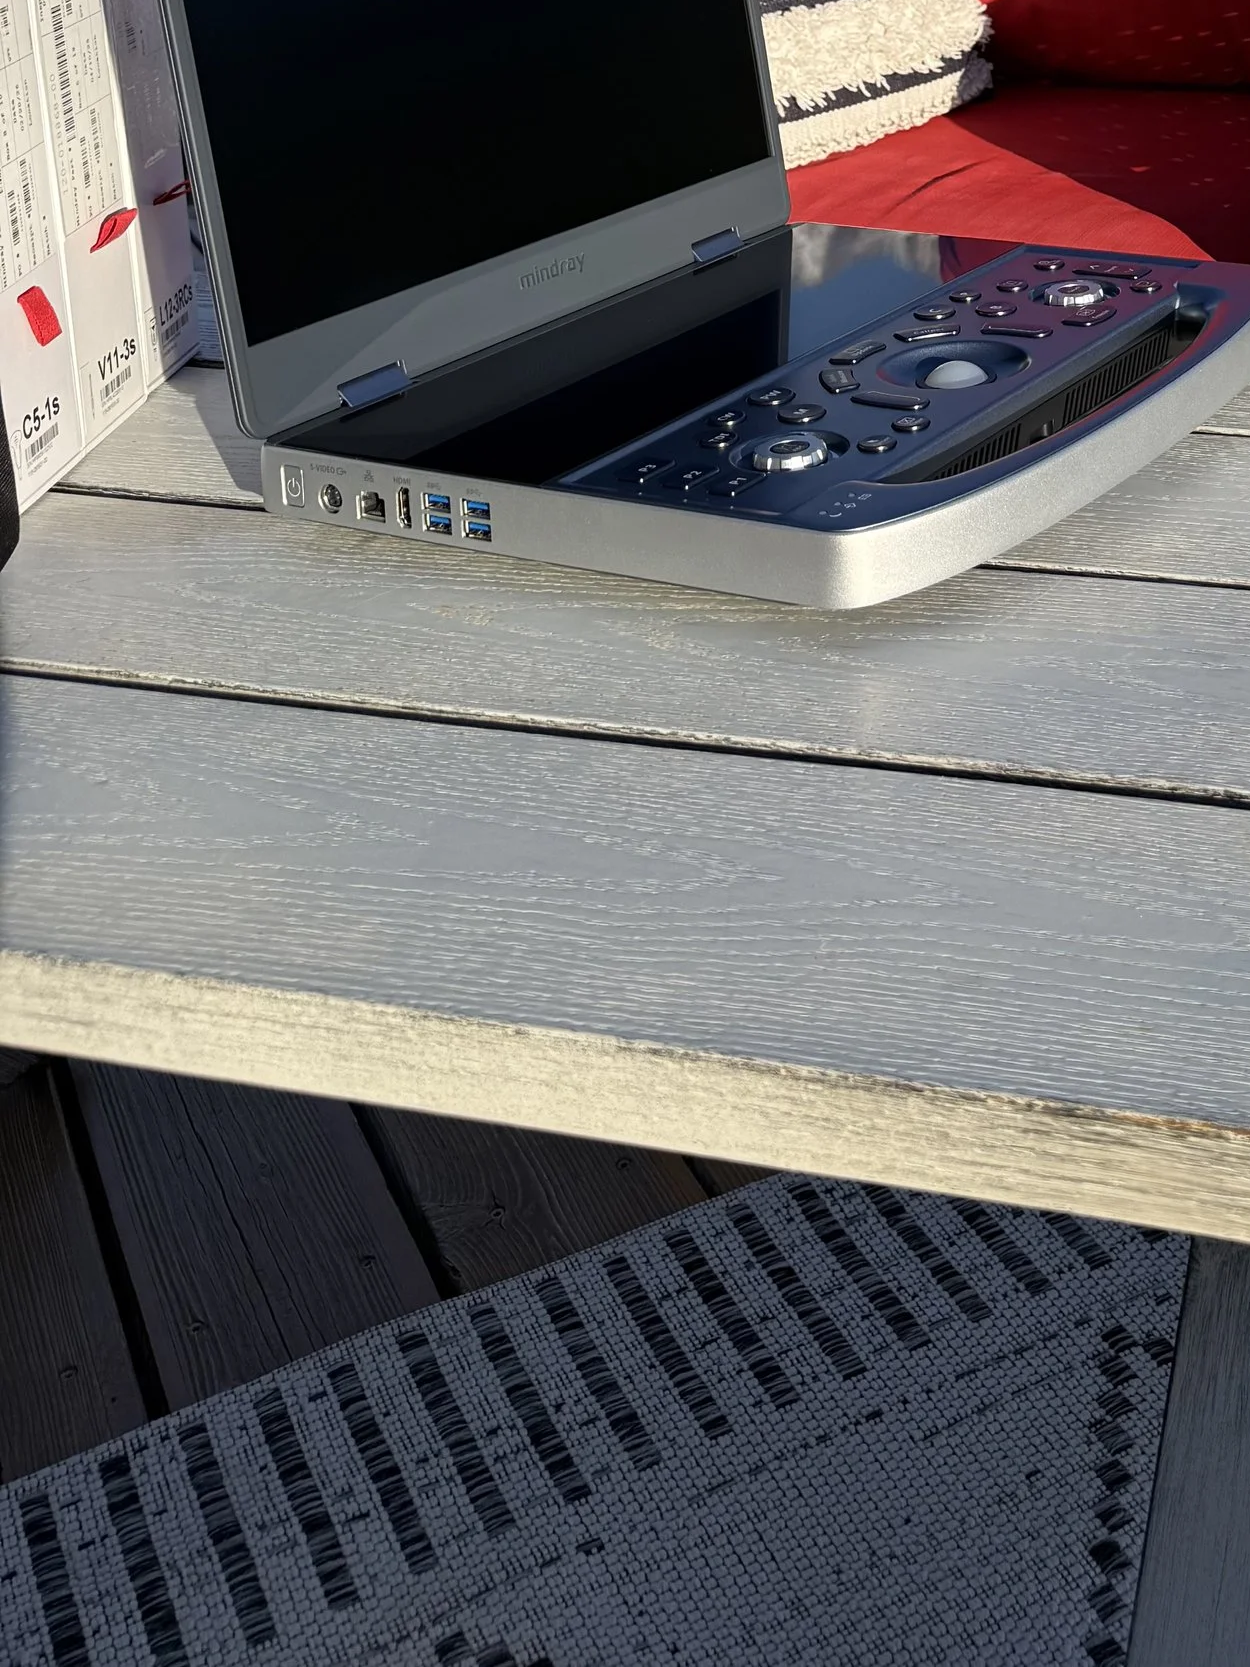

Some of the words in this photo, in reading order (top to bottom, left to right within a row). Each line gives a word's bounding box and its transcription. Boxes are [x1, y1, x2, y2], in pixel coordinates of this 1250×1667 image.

[519, 252, 584, 290] mindray
[160, 284, 193, 326] L12-3RCs
[98, 338, 136, 380] V11-3s
[23, 396, 60, 439] C5-1s
[638, 464, 657, 473] P3
[684, 470, 702, 479] P2
[393, 476, 412, 486] HDMI
[728, 476, 748, 486] P1
